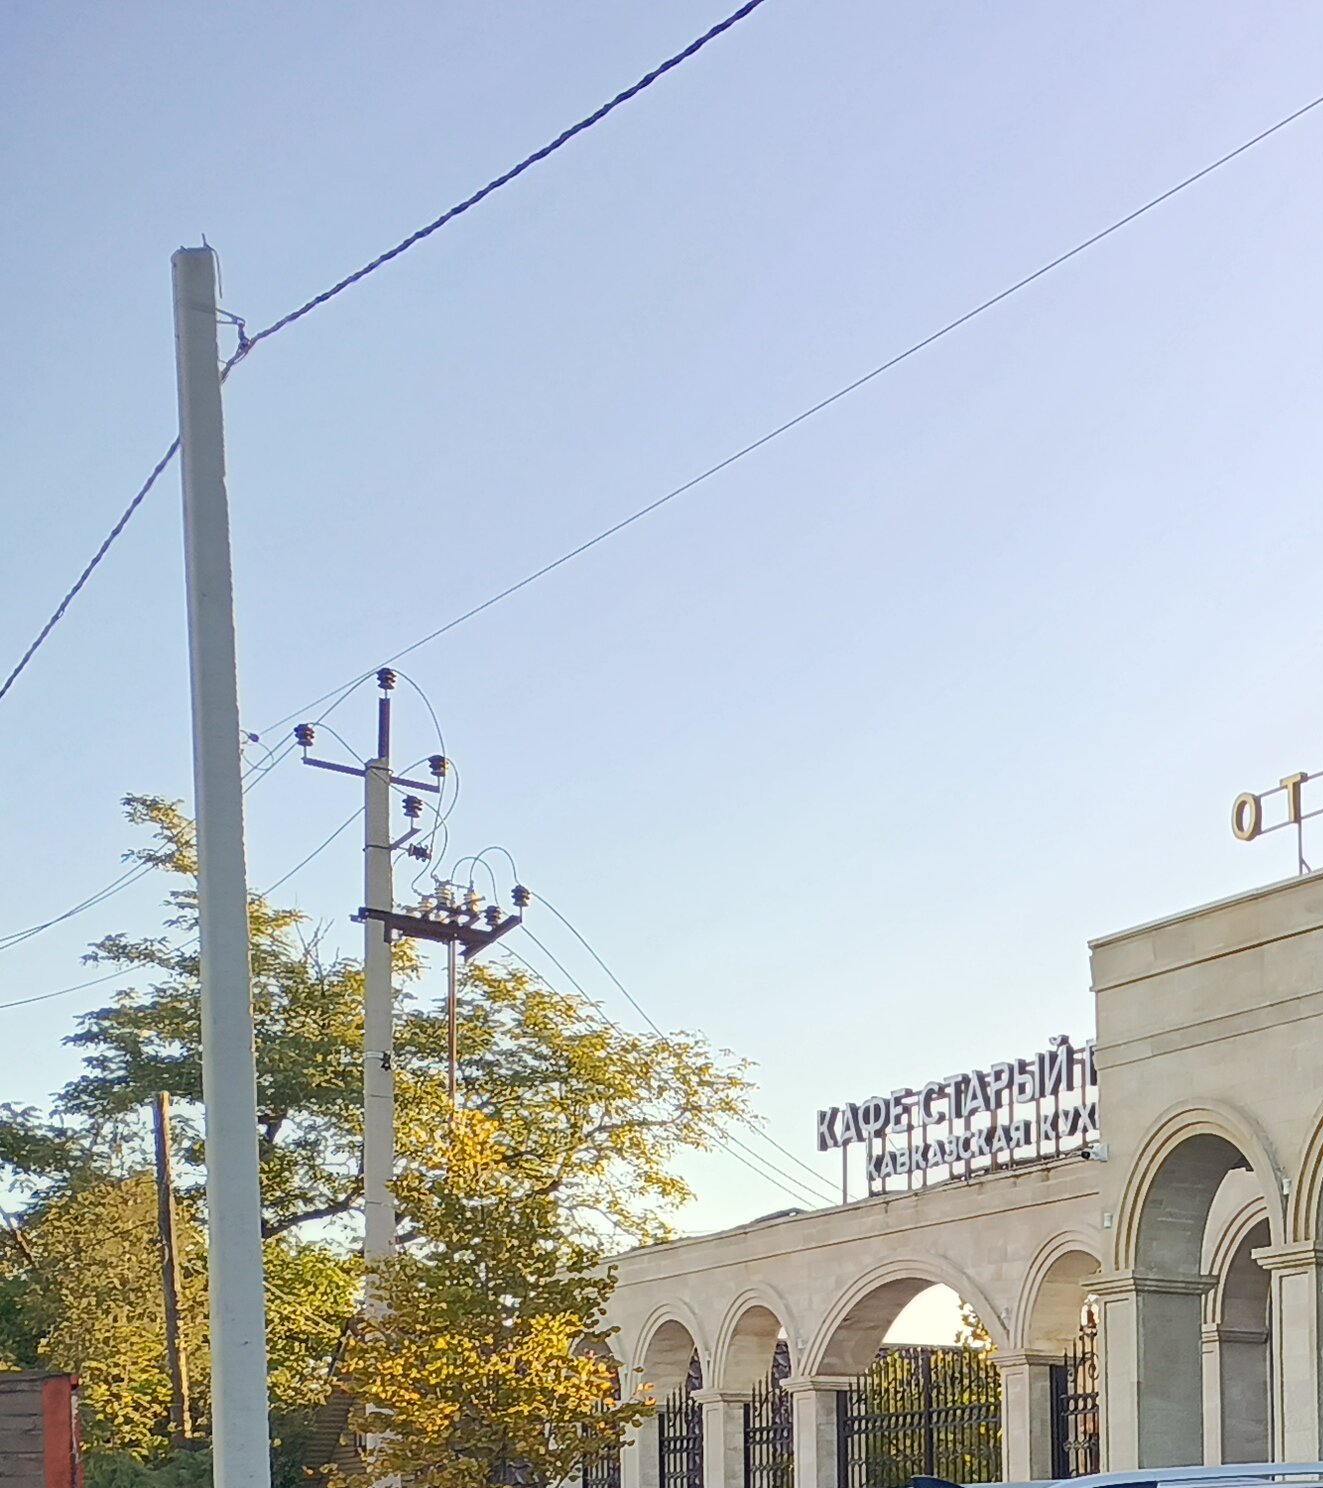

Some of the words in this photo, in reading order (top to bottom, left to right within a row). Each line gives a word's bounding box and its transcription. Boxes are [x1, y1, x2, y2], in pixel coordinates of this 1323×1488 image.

[817, 1088, 913, 1151] КАФЕ
[918, 1034, 1074, 1126] СТАРЫЙ
[866, 1119, 1032, 1181] КАВКАЗСКАЯ
[1040, 1102, 1099, 1141] КУХ
